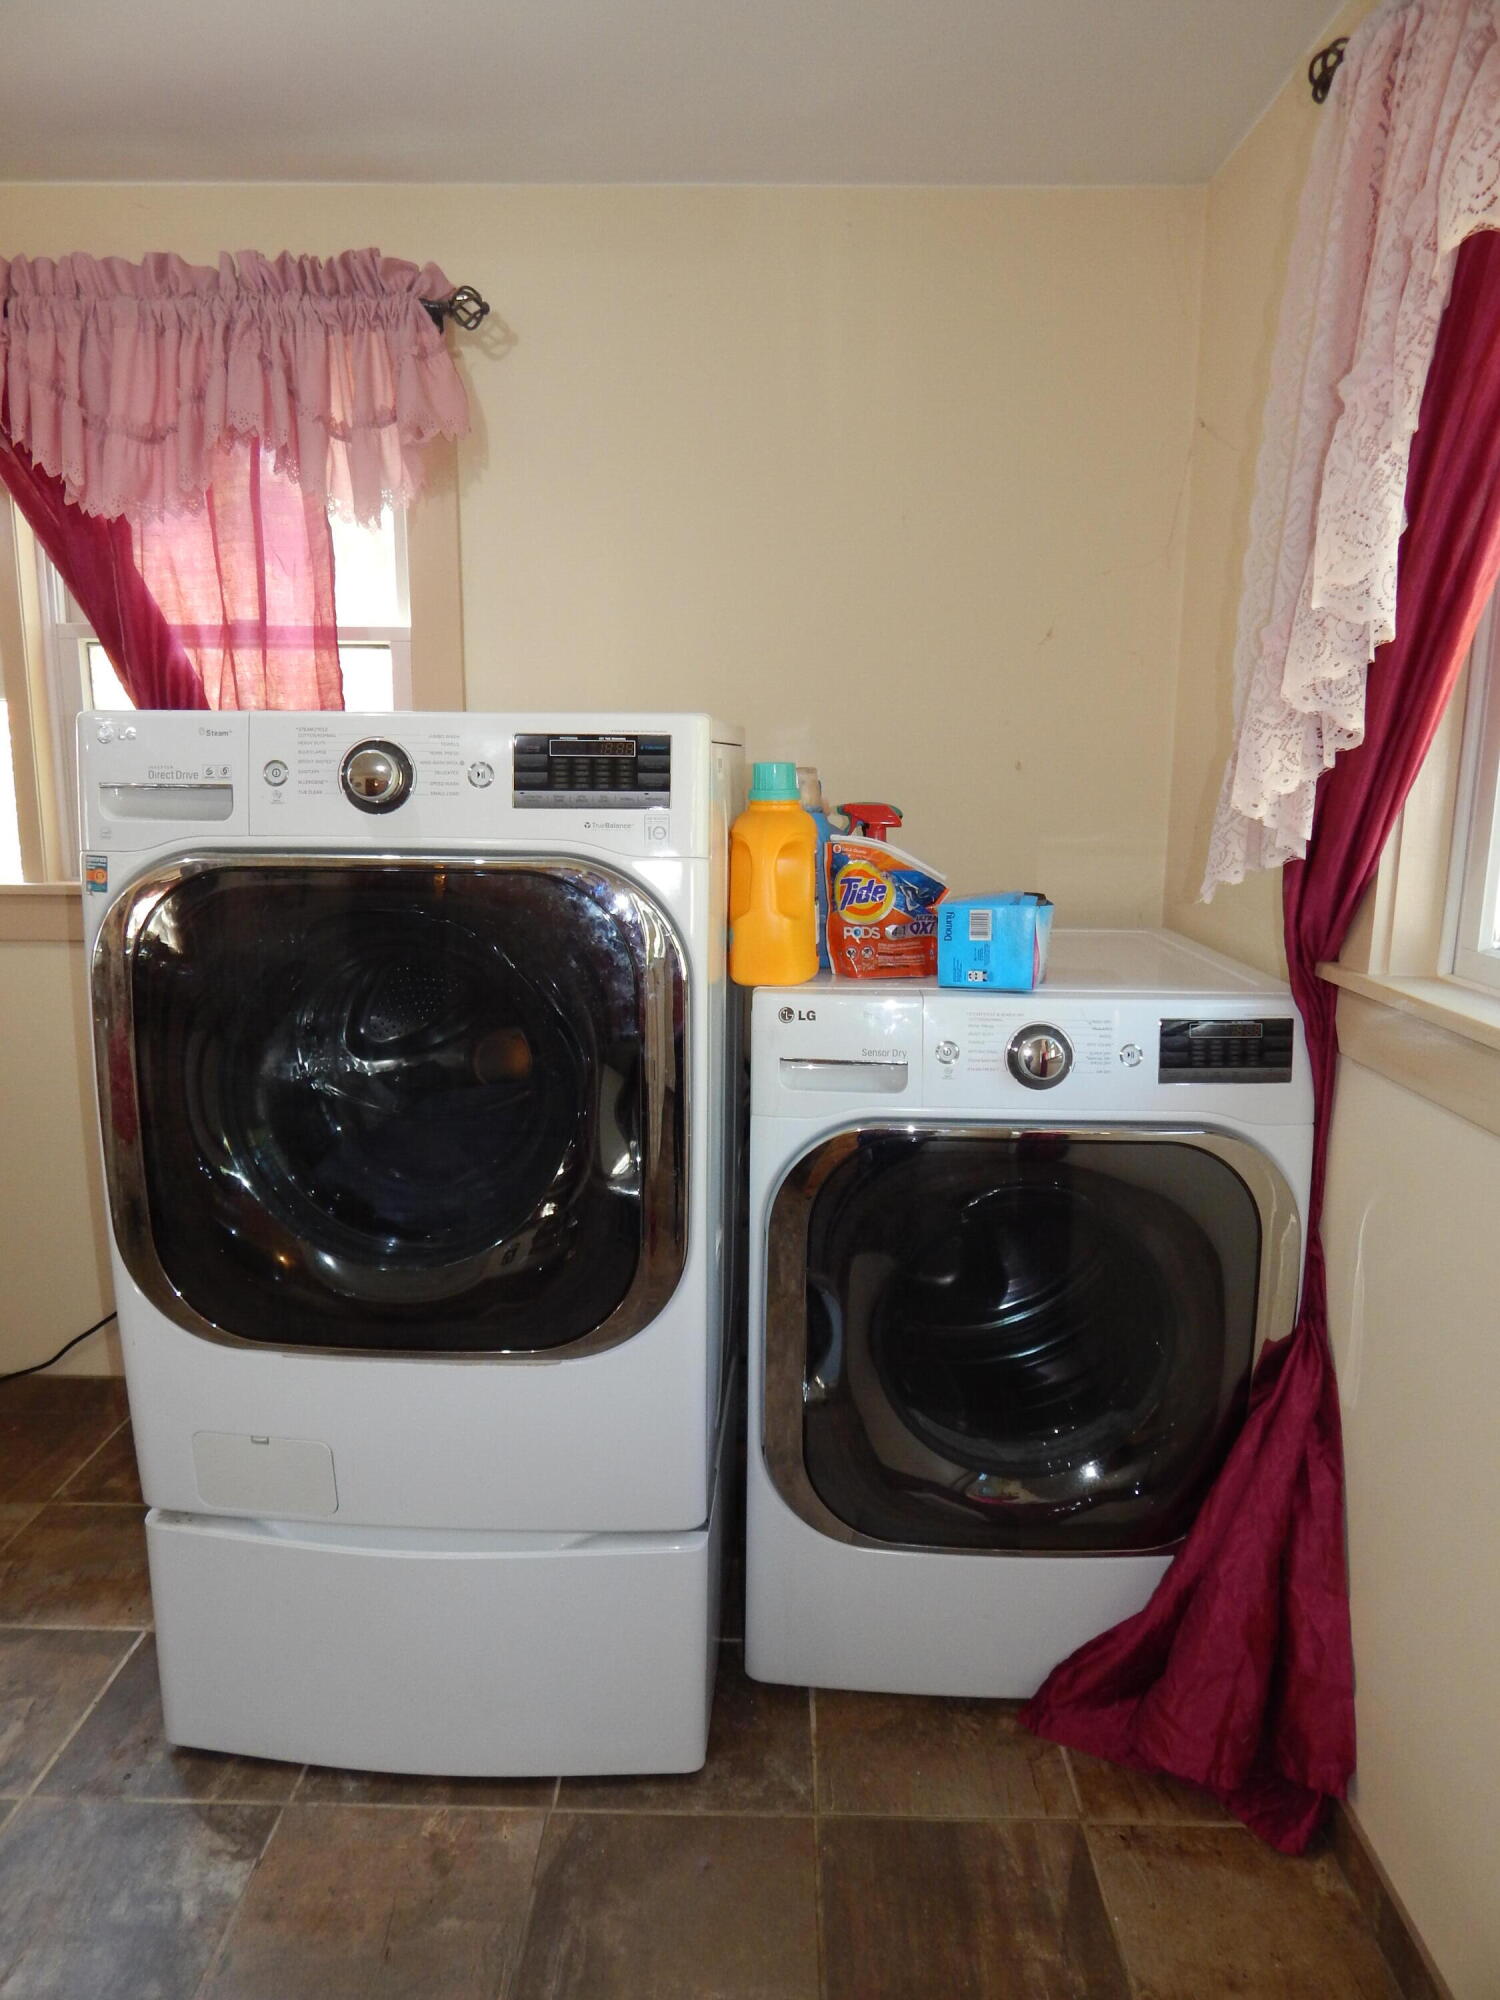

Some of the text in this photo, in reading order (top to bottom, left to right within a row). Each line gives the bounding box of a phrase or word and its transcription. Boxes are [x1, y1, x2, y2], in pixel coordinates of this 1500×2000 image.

[148, 770, 199, 780] Direct Drive
[839, 877, 888, 911] Tide
[909, 922, 935, 935] OXI
[944, 911, 956, 941] Downy
[843, 926, 881, 940] PODS
[798, 1010, 816, 1021] LG
[861, 1048, 908, 1058] Sensor Dry
